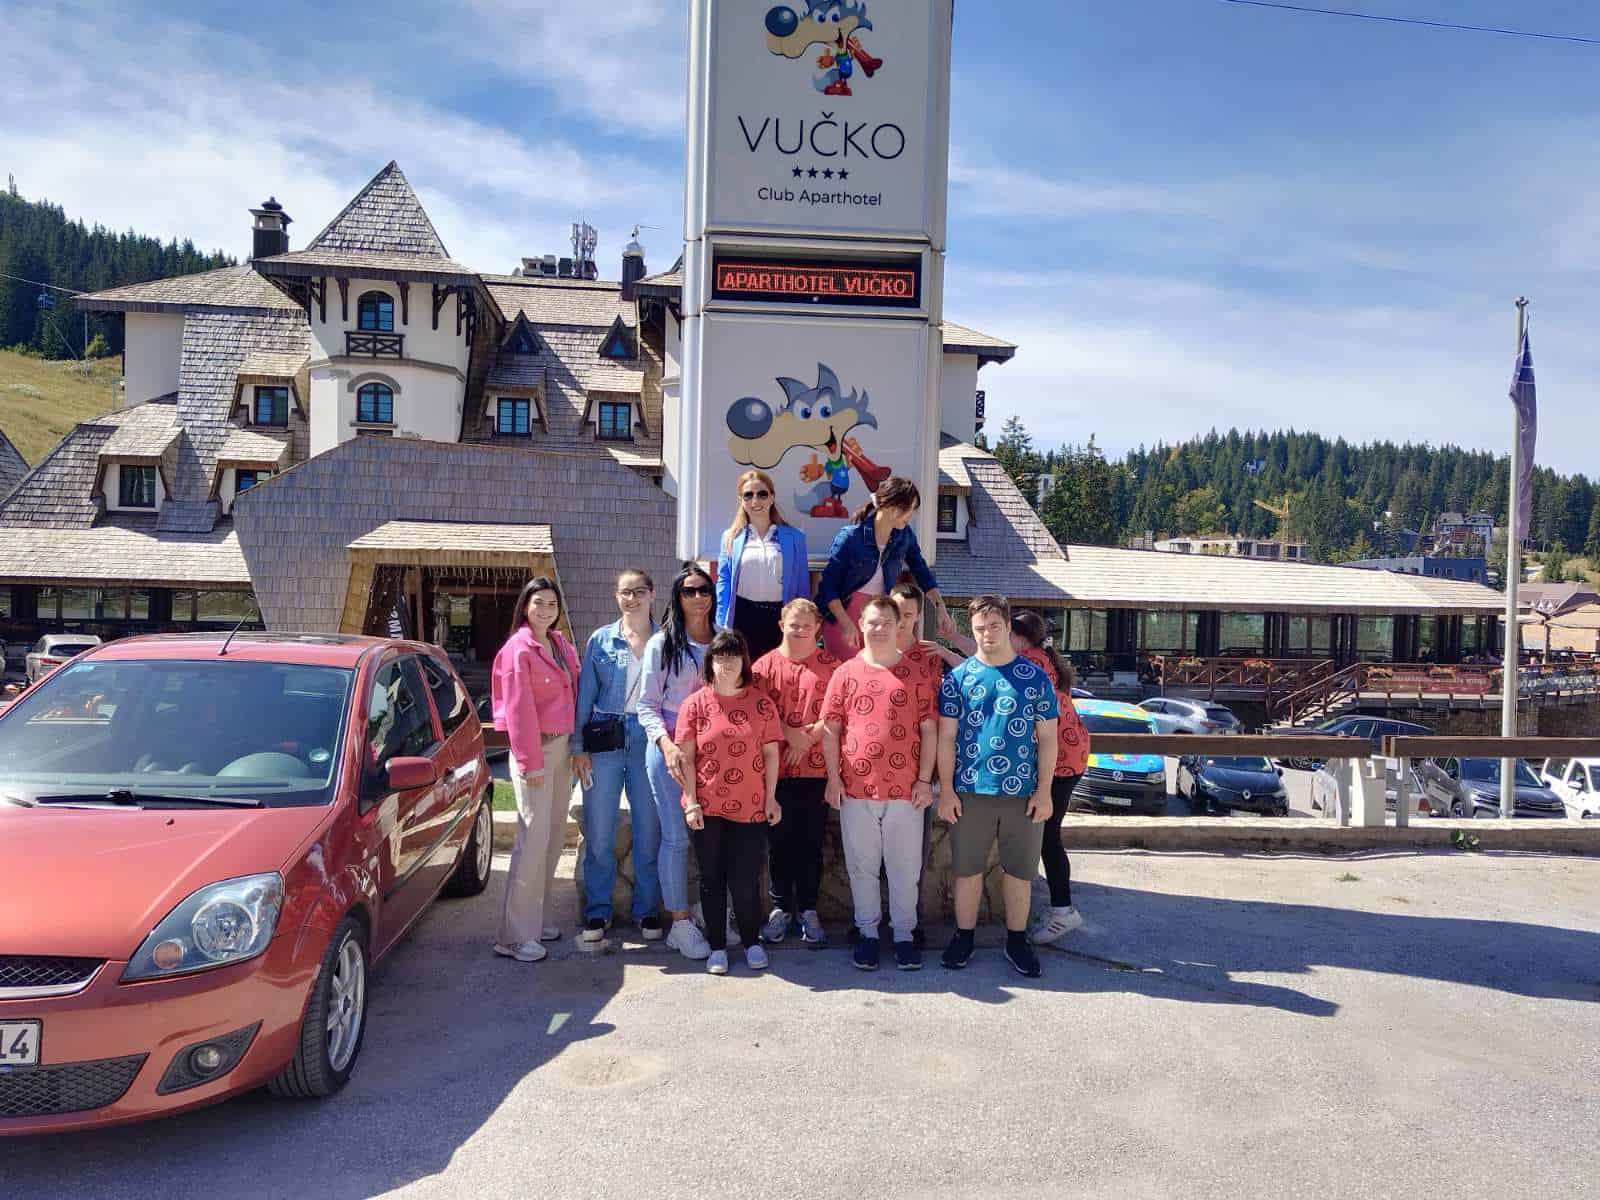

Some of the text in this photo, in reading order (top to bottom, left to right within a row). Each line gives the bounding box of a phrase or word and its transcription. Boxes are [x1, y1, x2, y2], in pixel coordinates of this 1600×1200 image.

[738, 111, 905, 160] VUČKO
[758, 187, 882, 206] Club Aparthotel
[723, 271, 907, 295] APARTHOTEL VUČKO
